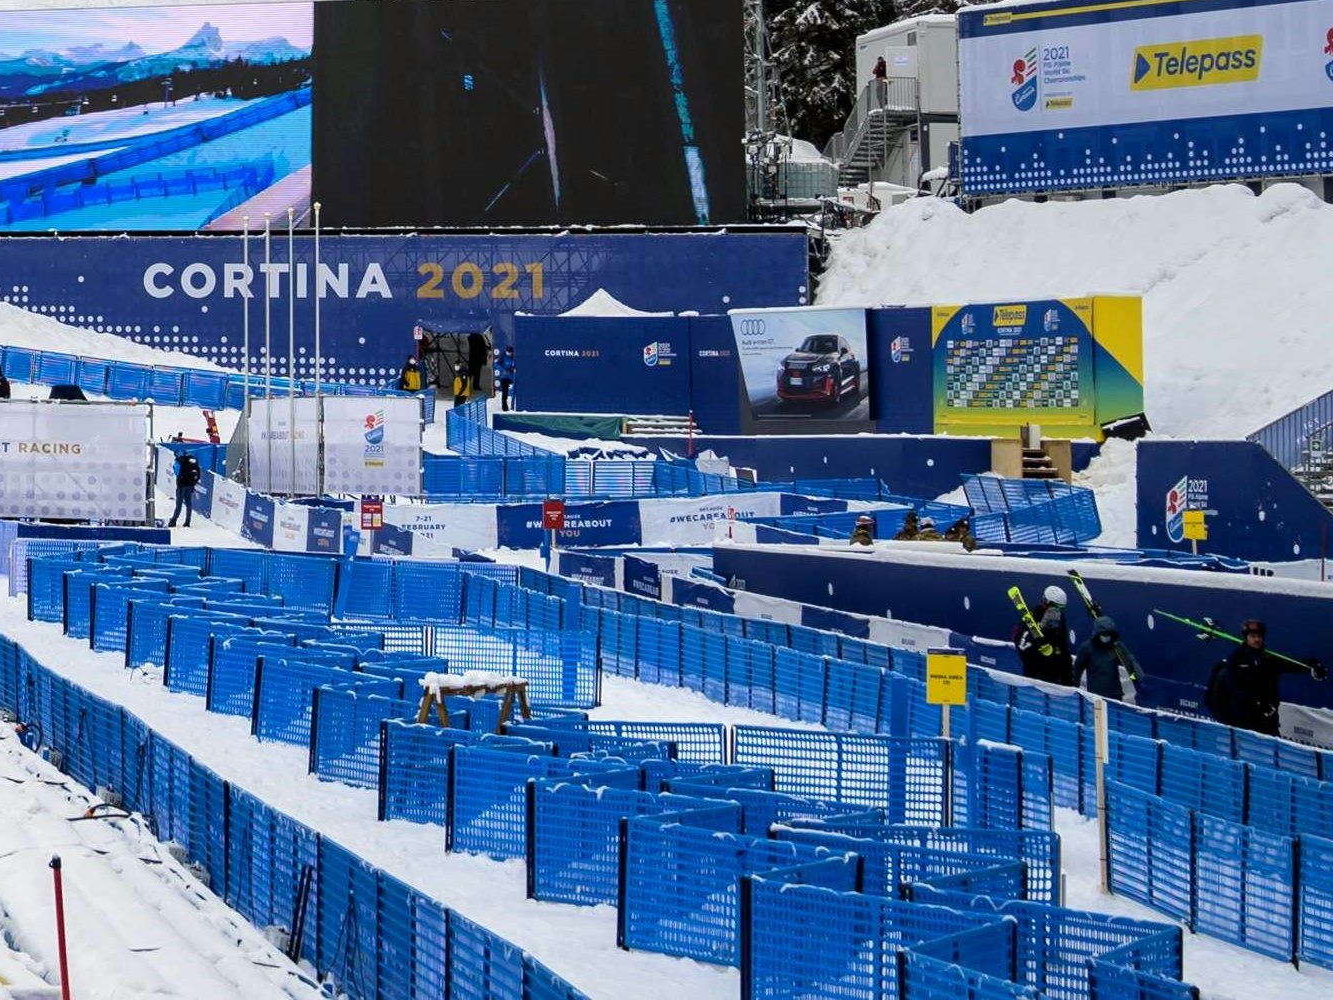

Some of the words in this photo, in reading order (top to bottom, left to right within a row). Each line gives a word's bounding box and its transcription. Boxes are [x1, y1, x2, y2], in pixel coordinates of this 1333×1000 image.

[1043, 46, 1070, 61] 2021
[1154, 47, 1256, 81] Telepass
[143, 262, 393, 298] CORTINA
[416, 262, 545, 299] 2021
[544, 349, 579, 357] CORTINA
[18, 442, 81, 455] RACING
[1188, 479, 1208, 493] 2021
[526, 519, 613, 529] #WREABOUT
[559, 530, 581, 538] YOU
